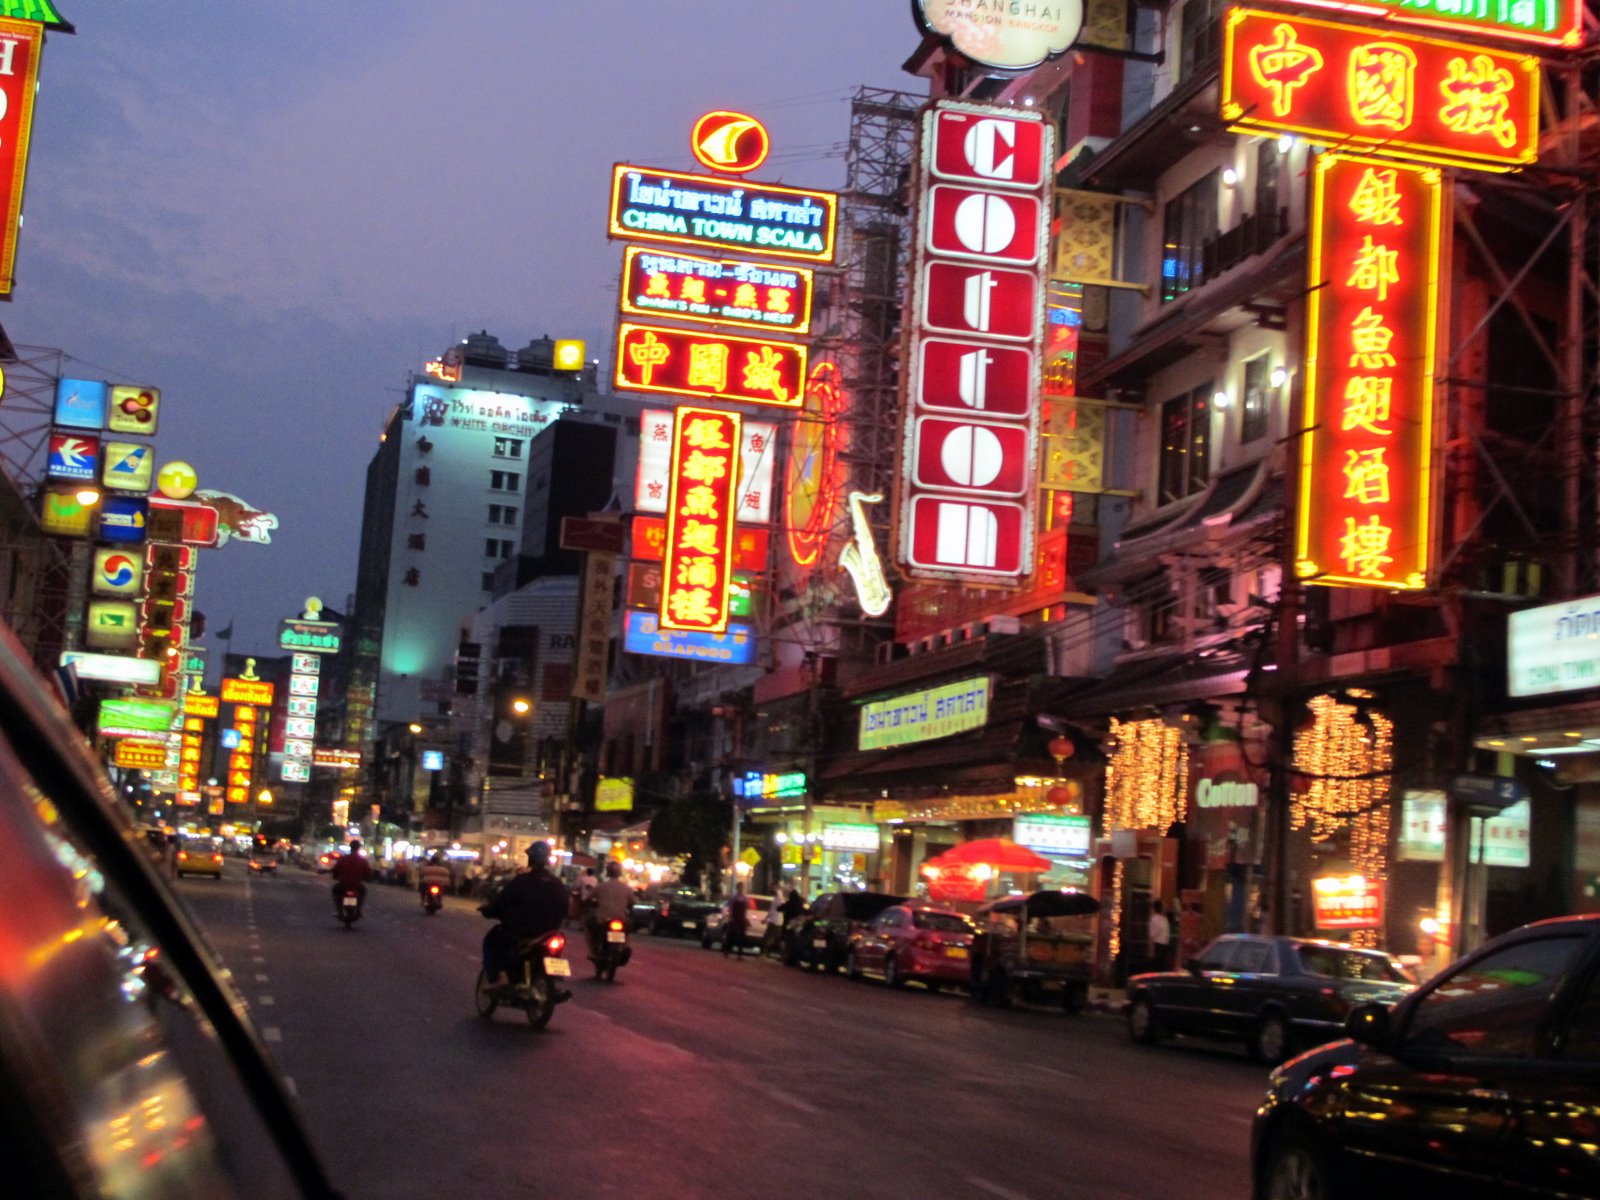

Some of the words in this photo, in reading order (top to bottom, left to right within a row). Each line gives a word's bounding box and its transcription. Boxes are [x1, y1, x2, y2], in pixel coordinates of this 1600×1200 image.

[623, 209, 688, 233] CHINA
[692, 218, 753, 241] TOWN
[755, 226, 823, 250] SCALA
[629, 331, 788, 402] 中國城
[452, 417, 487, 432] WHITE
[653, 641, 732, 659] SEAFOOD
